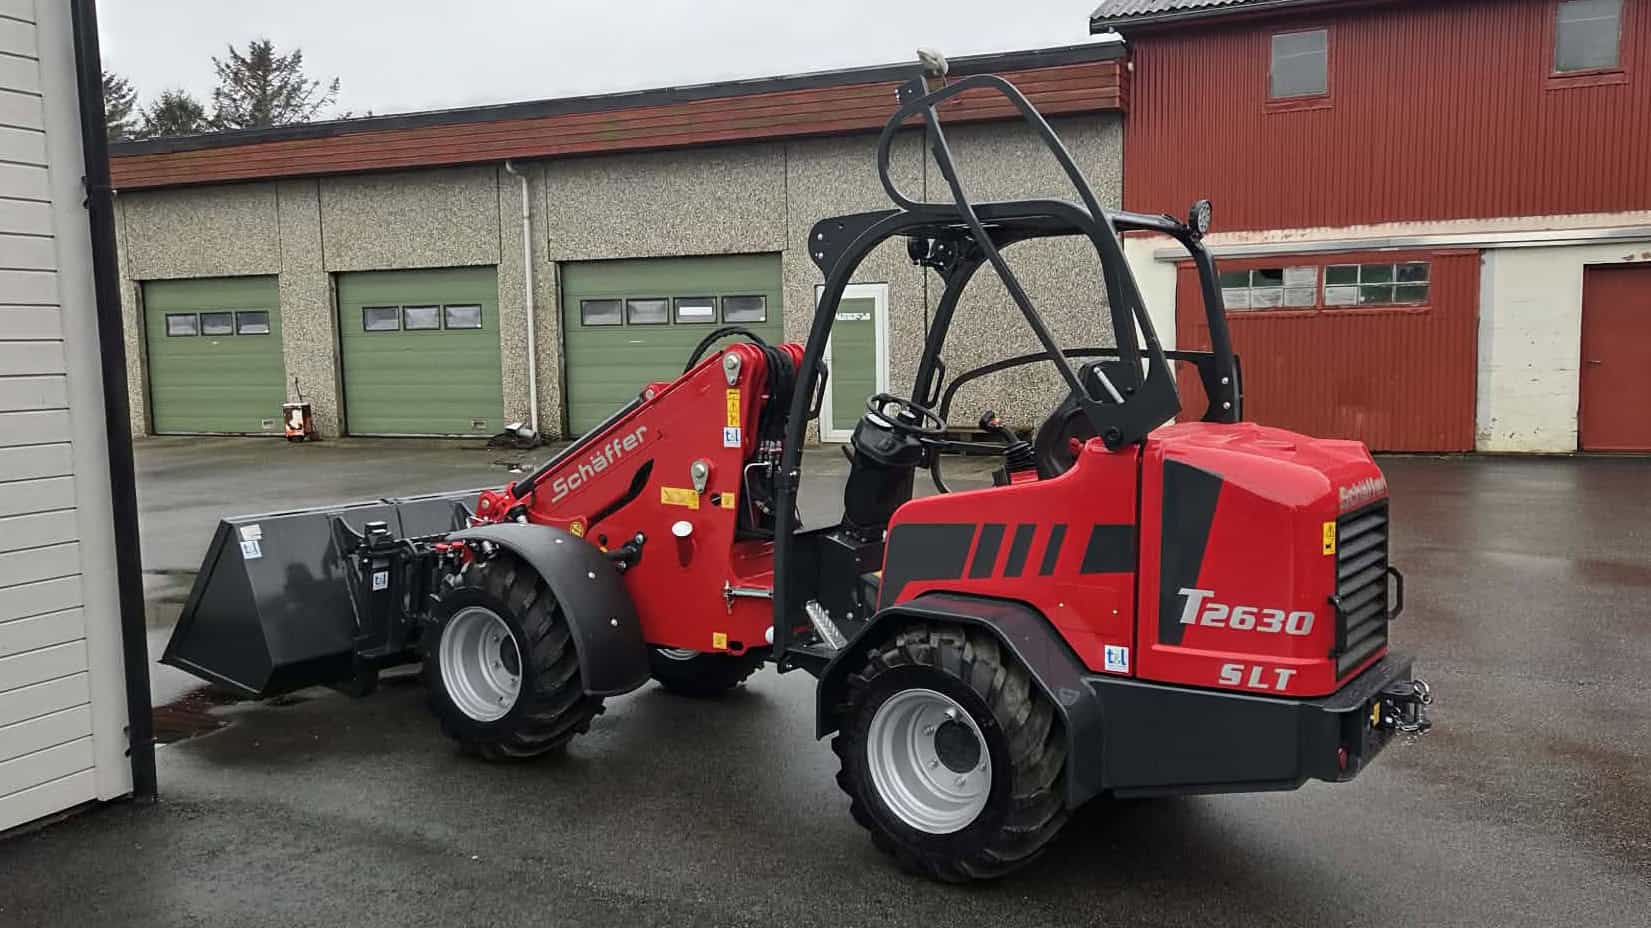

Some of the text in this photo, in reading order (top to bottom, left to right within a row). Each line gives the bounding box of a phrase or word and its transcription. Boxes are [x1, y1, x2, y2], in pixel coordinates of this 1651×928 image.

[552, 426, 647, 503] Schäffer
[1178, 587, 1315, 636] T2630
[1218, 663, 1297, 691] SLT
